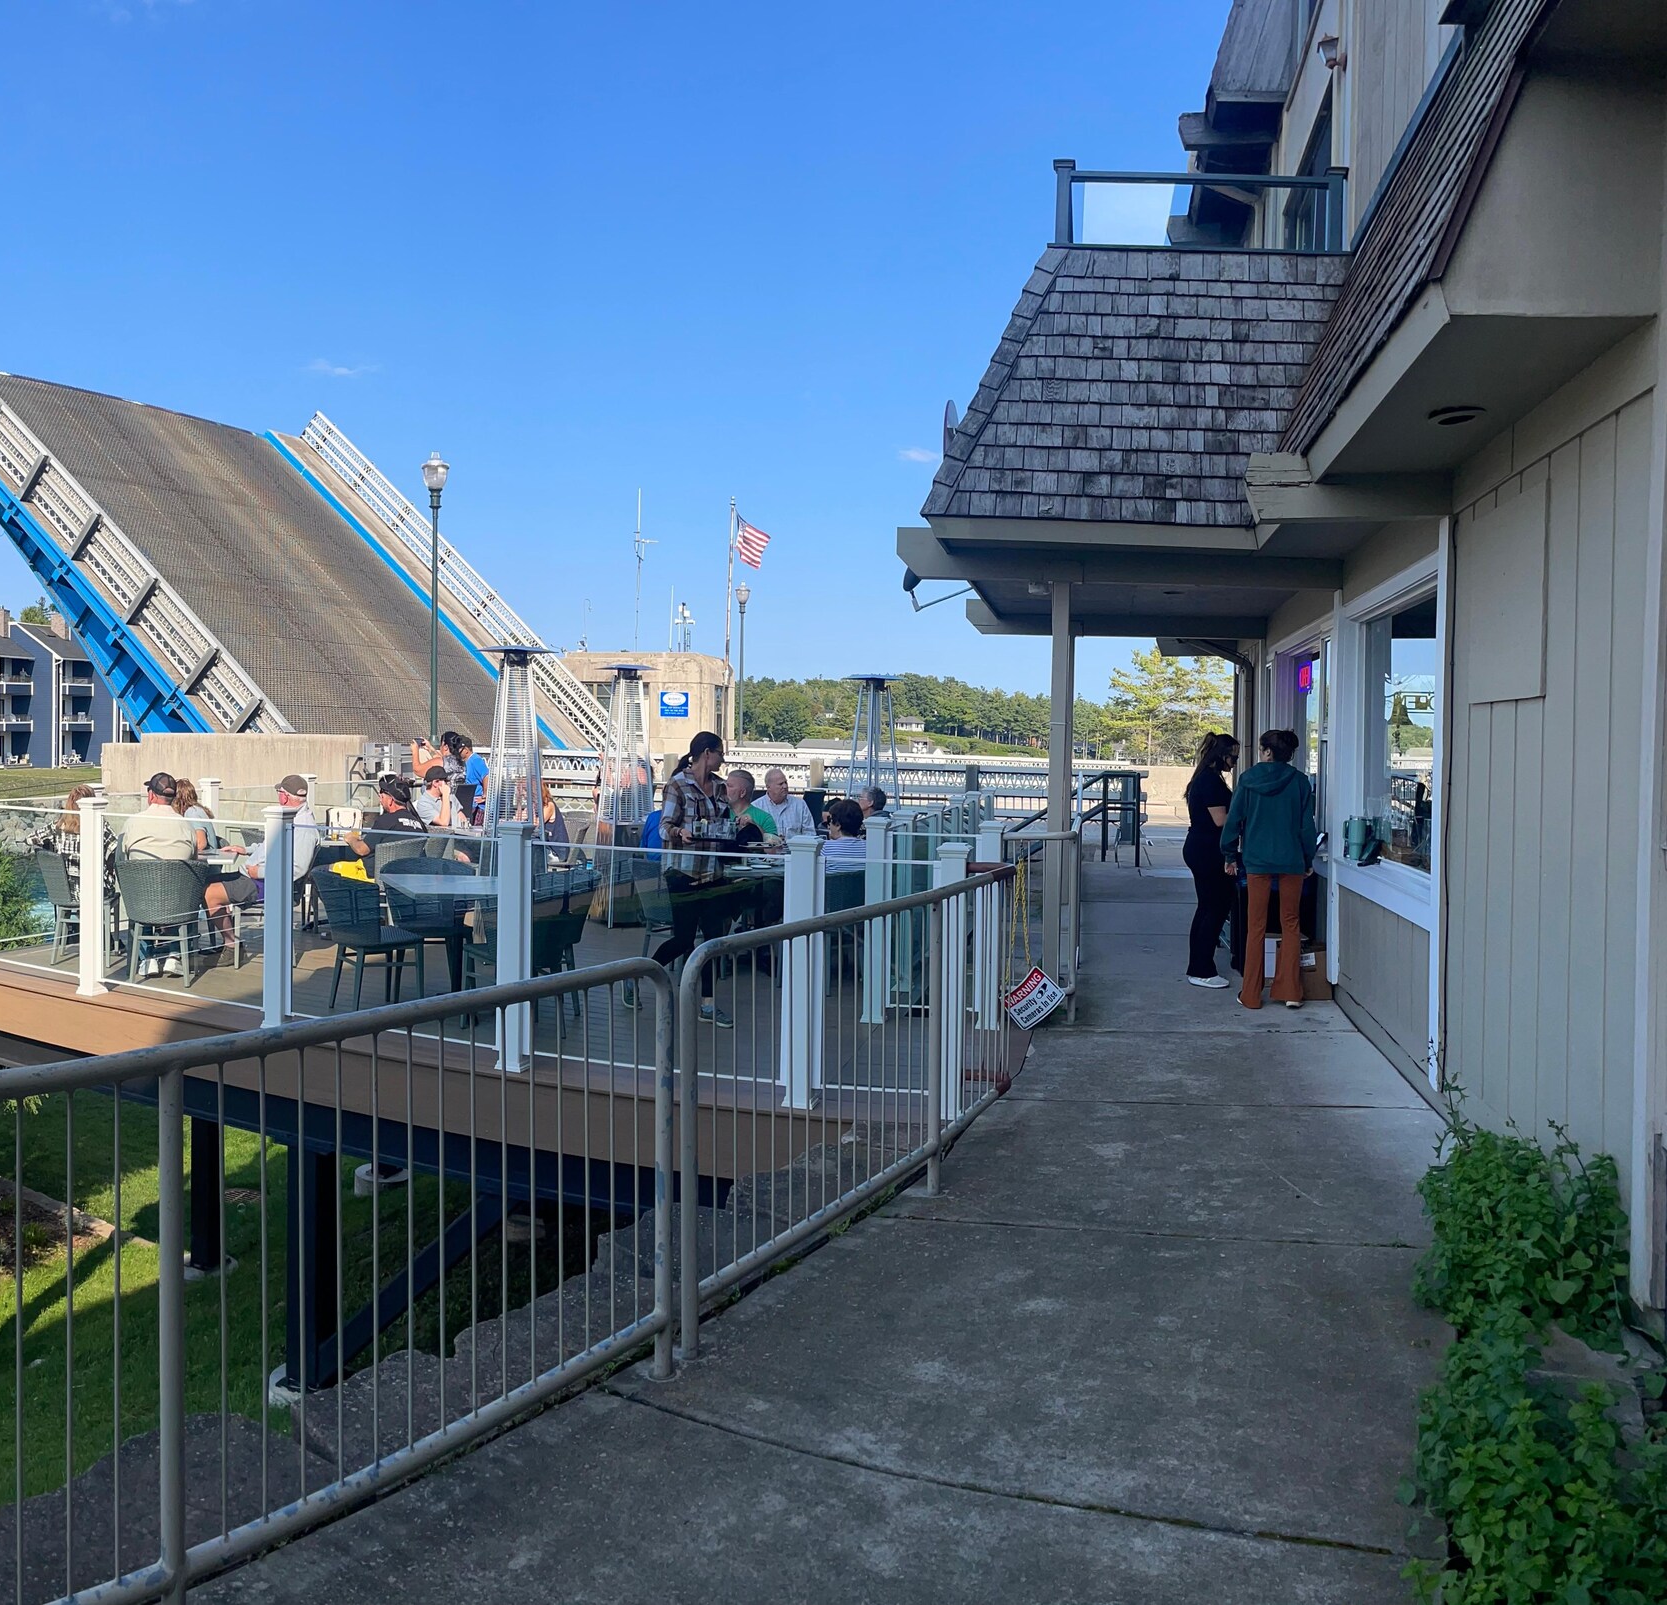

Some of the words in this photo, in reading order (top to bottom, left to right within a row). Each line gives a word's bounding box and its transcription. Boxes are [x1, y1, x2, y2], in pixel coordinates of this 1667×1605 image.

[1005, 972, 1042, 1006] WARNING
[1013, 998, 1038, 1016] Security
[1021, 1006, 1044, 1023] Cameras
[1041, 1000, 1050, 1008] In
[1047, 991, 1058, 1002] Use
